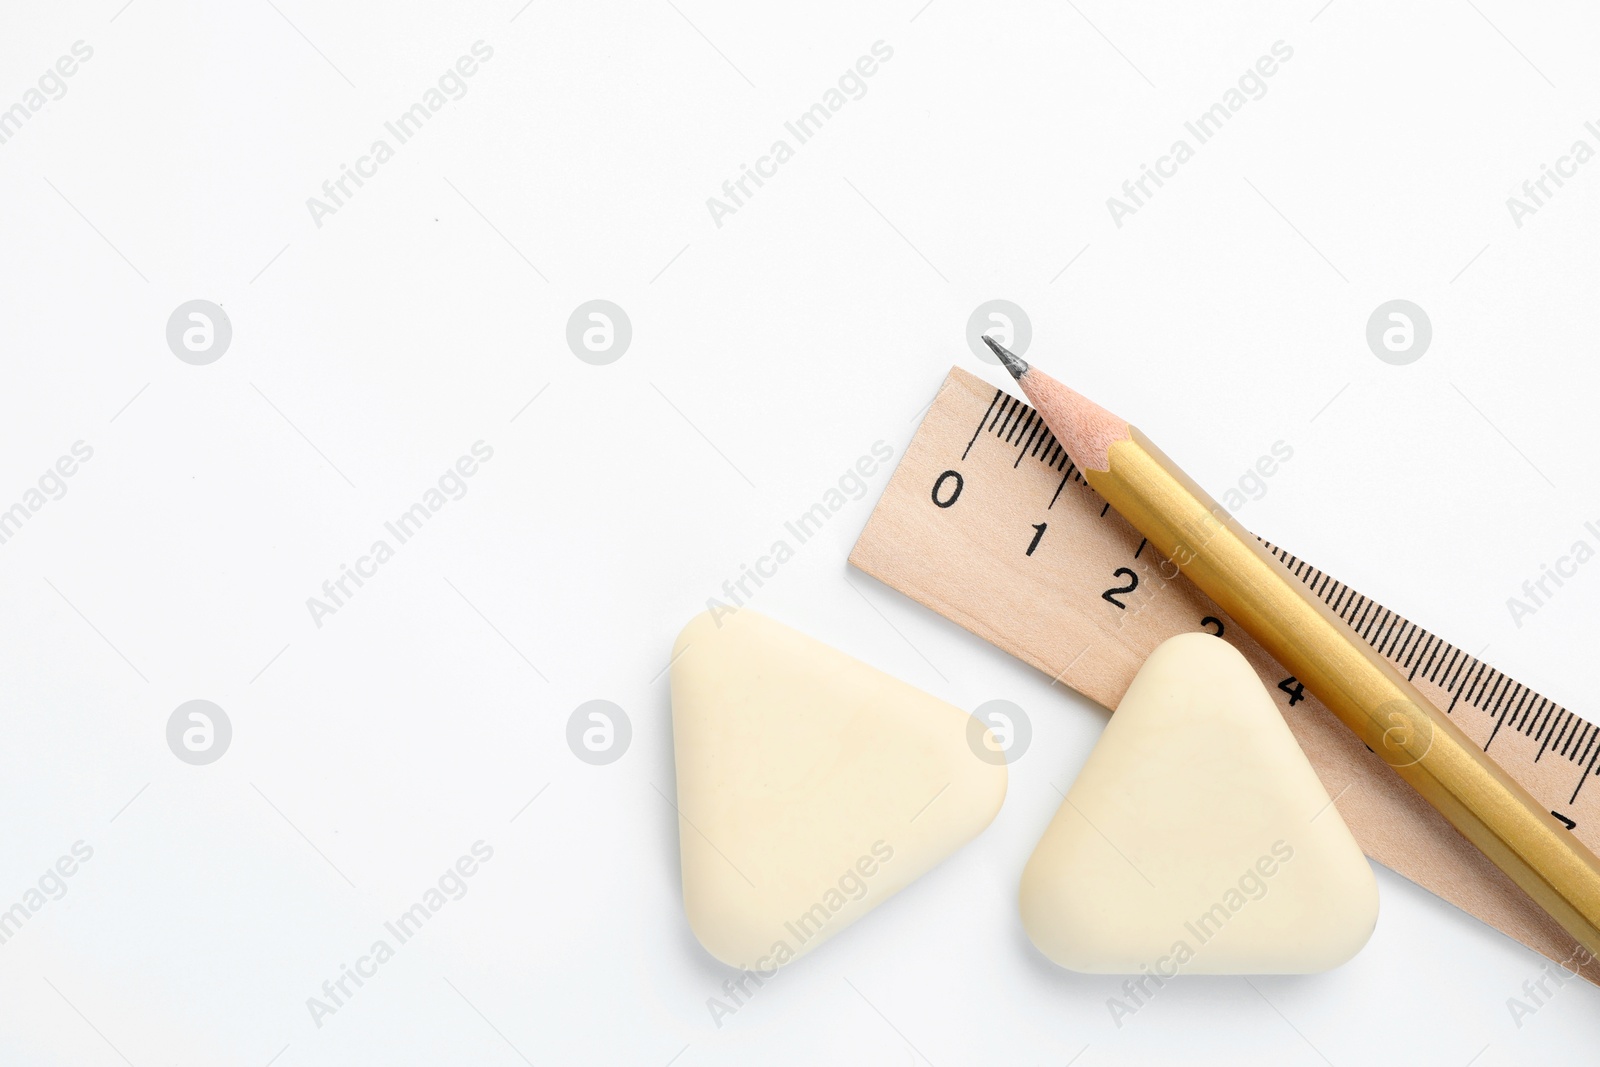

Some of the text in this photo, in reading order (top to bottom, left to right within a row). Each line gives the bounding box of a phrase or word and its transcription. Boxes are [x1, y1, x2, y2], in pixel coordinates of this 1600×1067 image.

[931, 470, 964, 509] 0
[1025, 522, 1048, 557] 1
[1101, 567, 1139, 610] 2
[1277, 676, 1305, 707] 4
